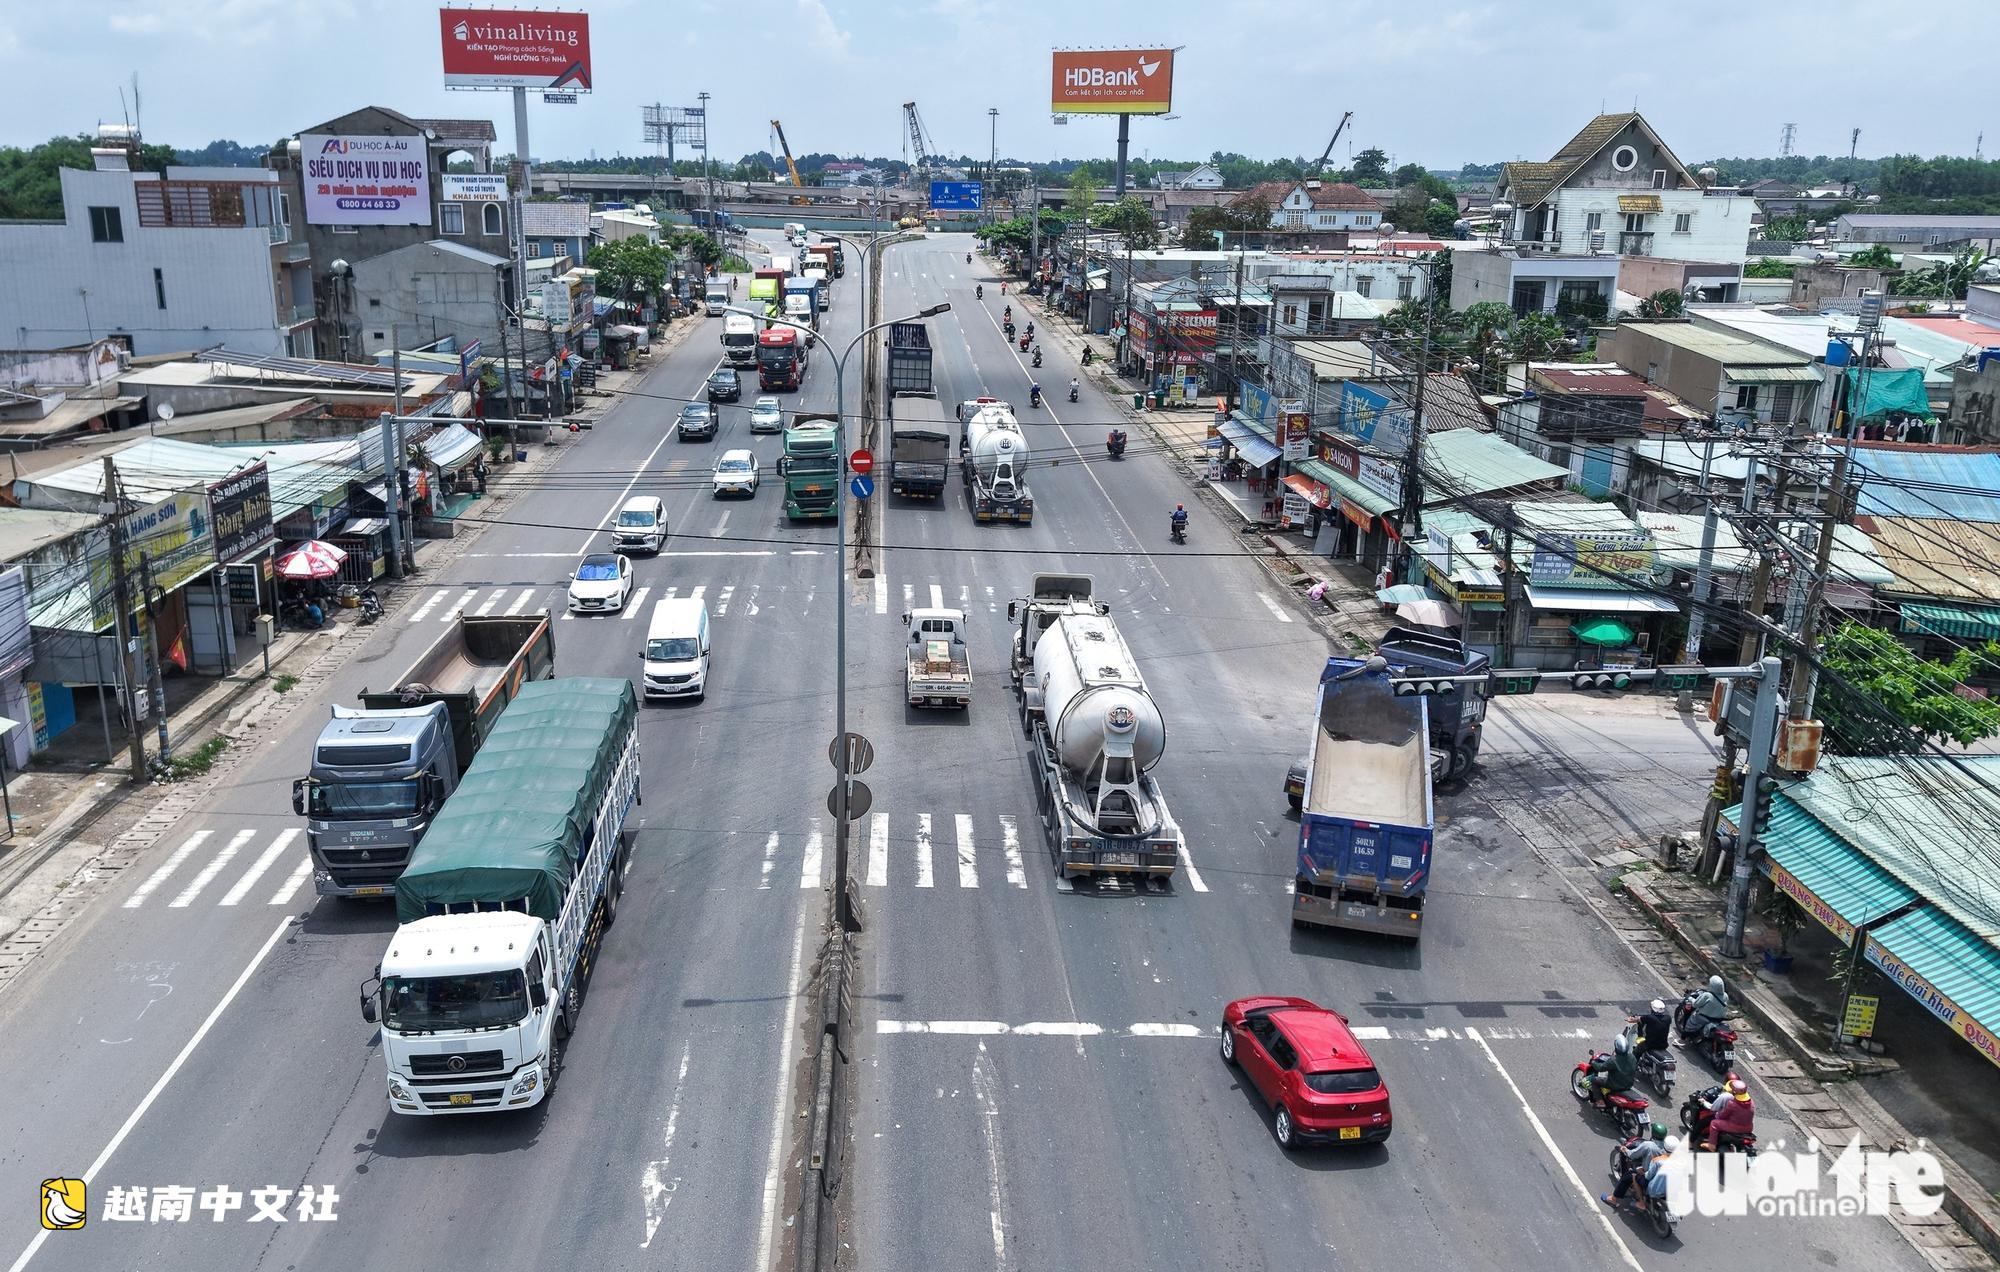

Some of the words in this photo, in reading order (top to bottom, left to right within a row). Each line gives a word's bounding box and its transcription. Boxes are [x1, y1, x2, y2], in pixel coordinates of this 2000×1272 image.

[474, 22, 578, 46] vinaliving
[484, 45, 498, 53] TẠO
[499, 45, 520, 53] Phong
[552, 55, 567, 63] NHÀ
[1065, 66, 1138, 87] HDBank
[350, 140, 362, 151] DU
[363, 141, 383, 151] HỌC
[309, 156, 334, 178] SIÊU
[337, 161, 363, 182] DỊCH
[365, 161, 380, 182] VỤ
[383, 161, 398, 179] DU
[400, 161, 422, 183] HỌC
[333, 184, 354, 195] năm
[357, 185, 378, 195] kinh
[381, 185, 417, 198] nghiệm
[341, 200, 360, 209] 1800
[362, 200, 373, 209] 64
[374, 201, 384, 209] 68
[385, 201, 396, 209] 33
[1330, 448, 1353, 471] SAIGON
[130, 512, 157, 536] HÀNG
[158, 502, 177, 523] SƠN
[1777, 872, 1812, 908] QUANG
[1928, 992, 1957, 1022] Khát
